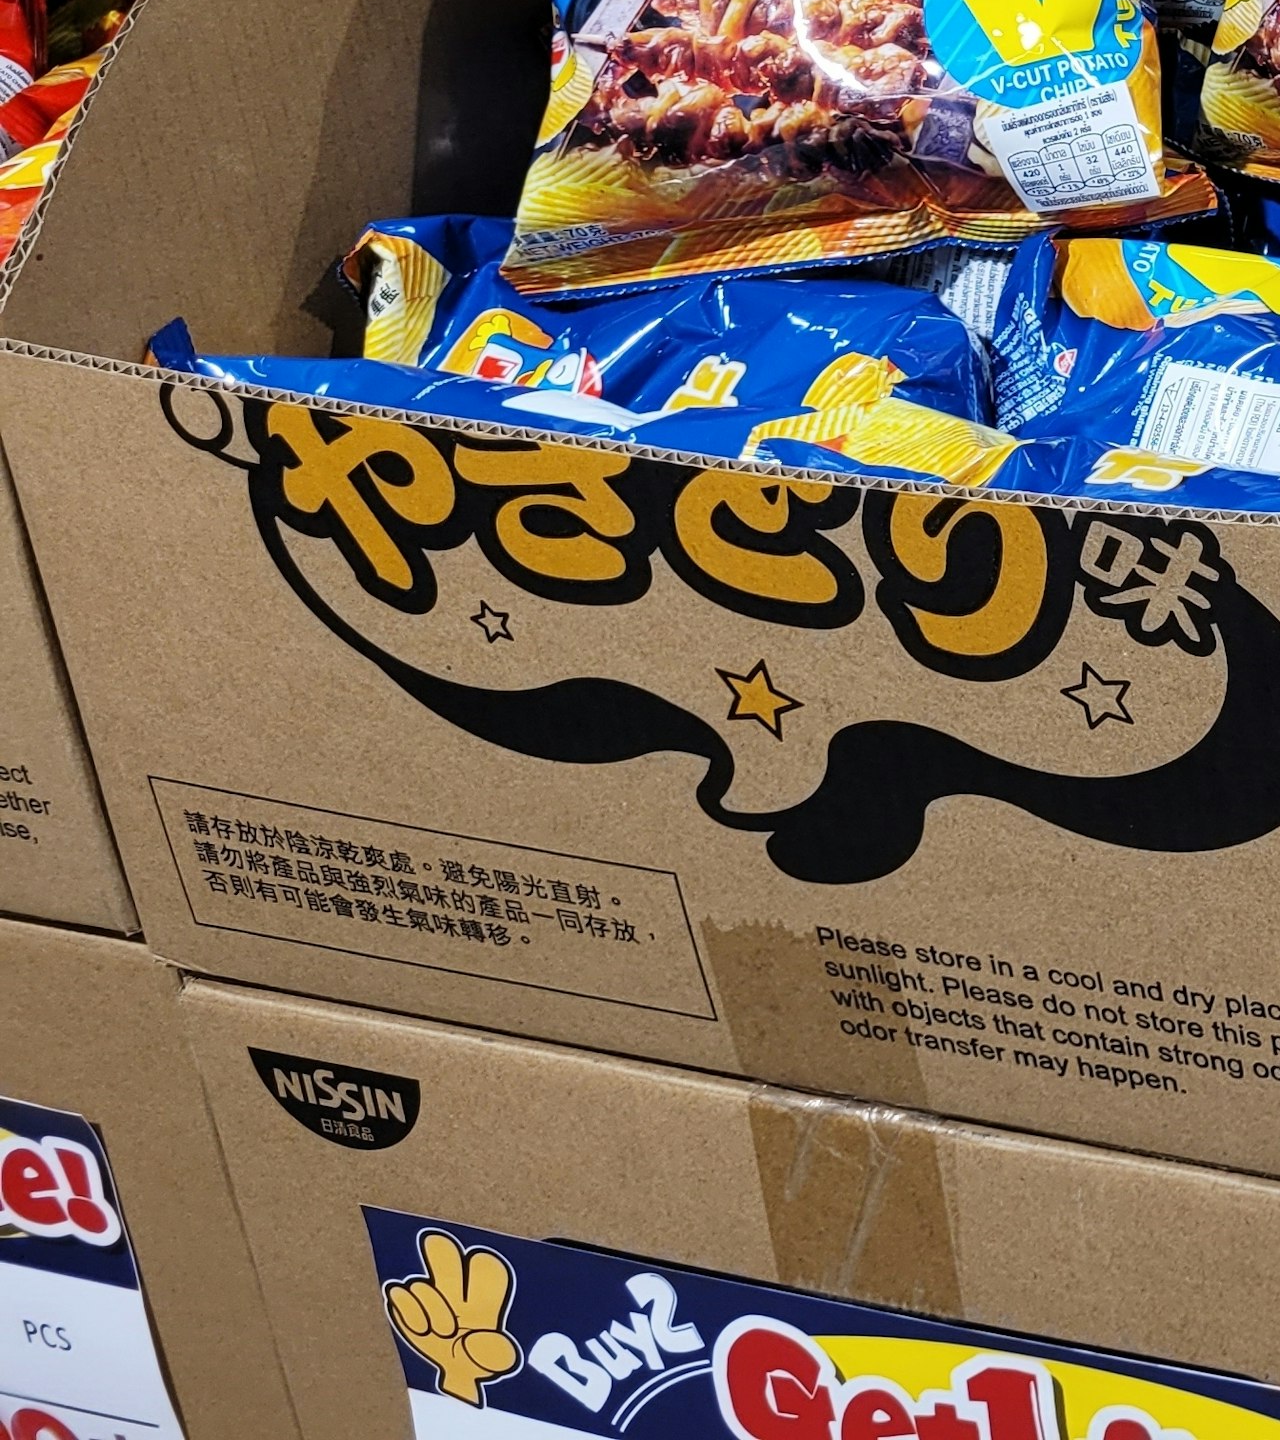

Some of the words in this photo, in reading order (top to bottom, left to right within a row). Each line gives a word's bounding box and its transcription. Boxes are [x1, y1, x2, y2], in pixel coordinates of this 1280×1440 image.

[990, 65, 1053, 95] V-CUT
[1057, 52, 1129, 77] POTATO
[273, 1067, 407, 1125] NISSIN
[320, 1116, 375, 1144] 日清食品
[22, 1319, 72, 1351] PCS
